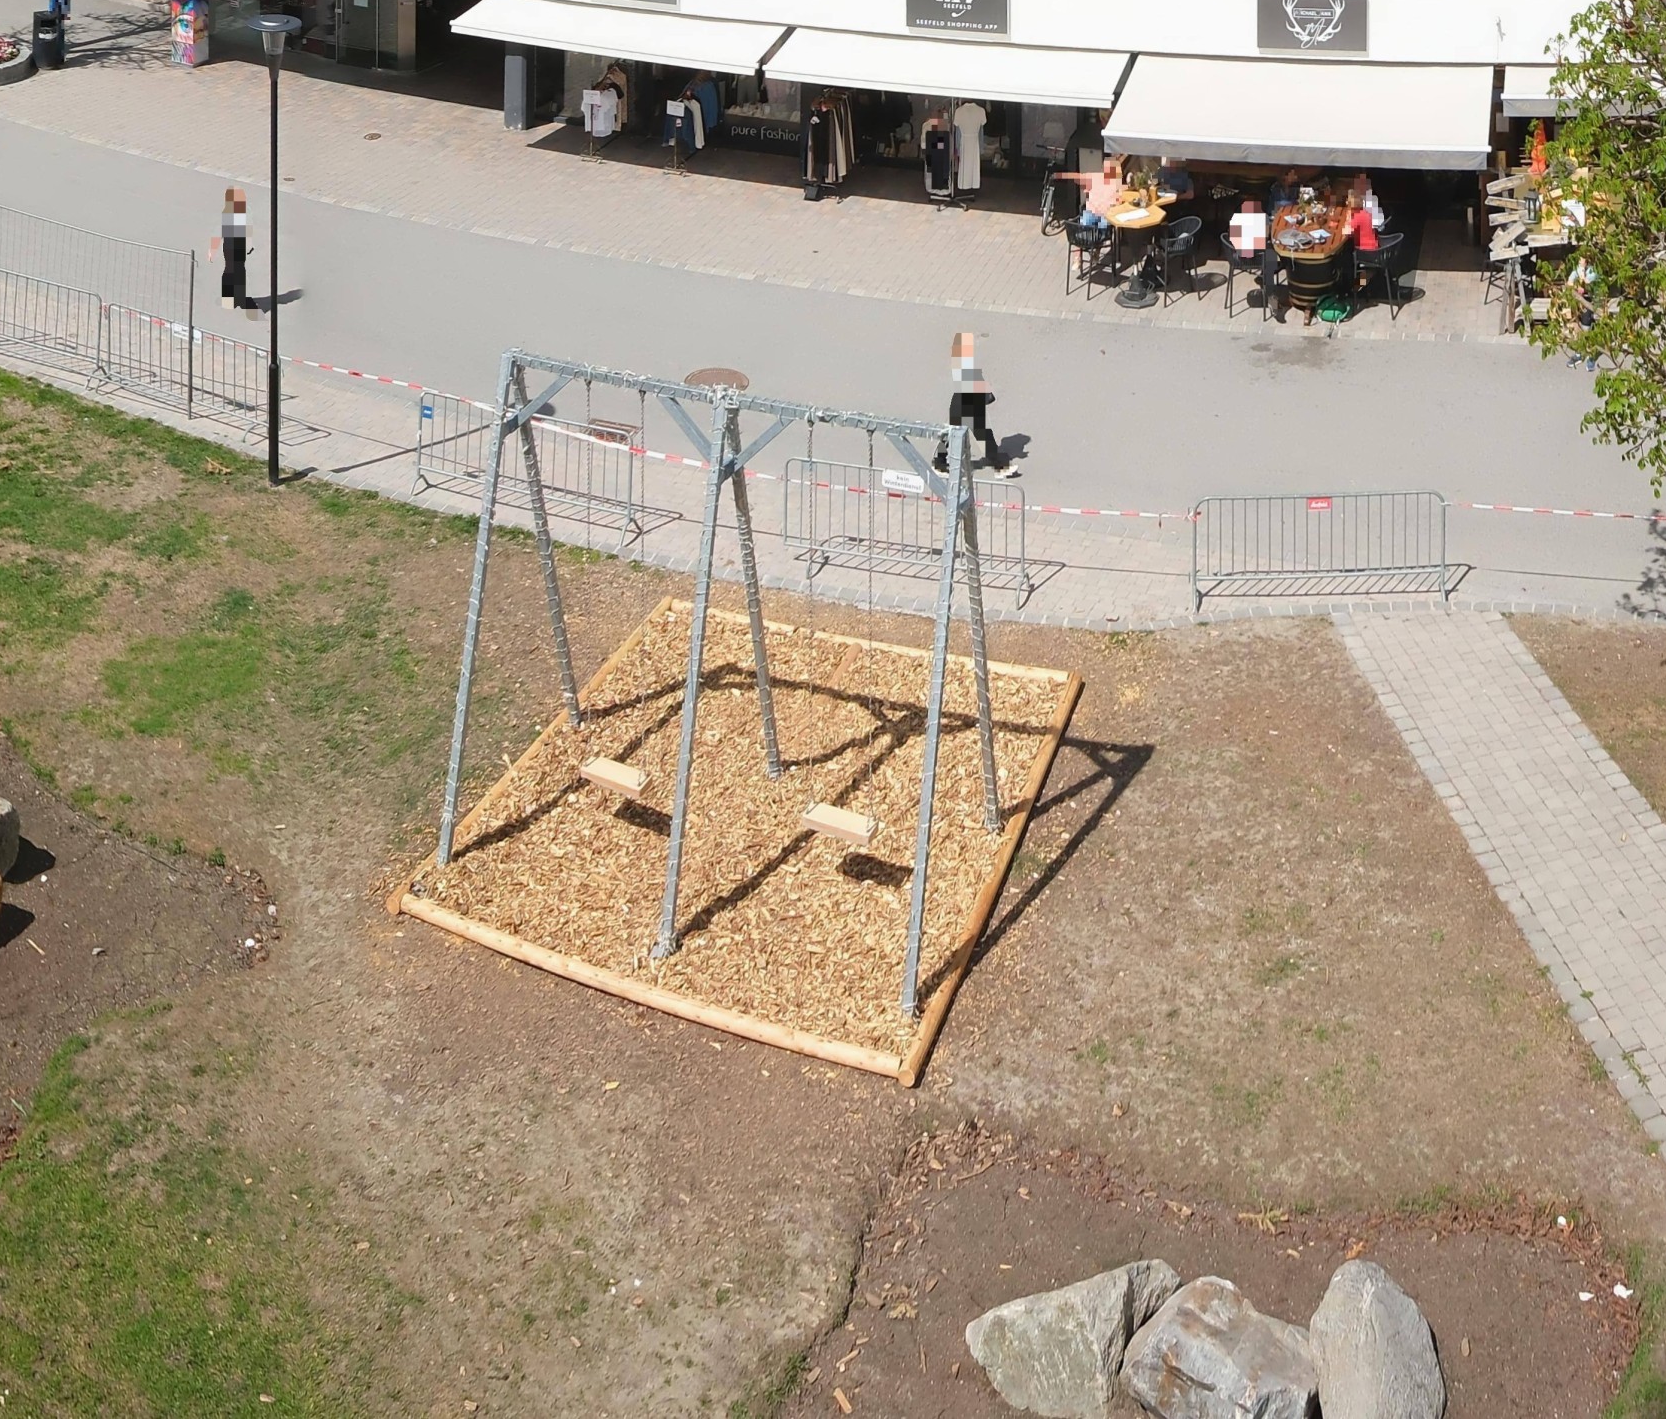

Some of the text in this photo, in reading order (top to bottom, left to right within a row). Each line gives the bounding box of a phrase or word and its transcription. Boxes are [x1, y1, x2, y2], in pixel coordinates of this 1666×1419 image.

[943, 2, 972, 11] SEEFELD
[916, 18, 945, 27] SEEFELD
[946, 21, 983, 30] SHOPPING
[731, 124, 757, 137] pure
